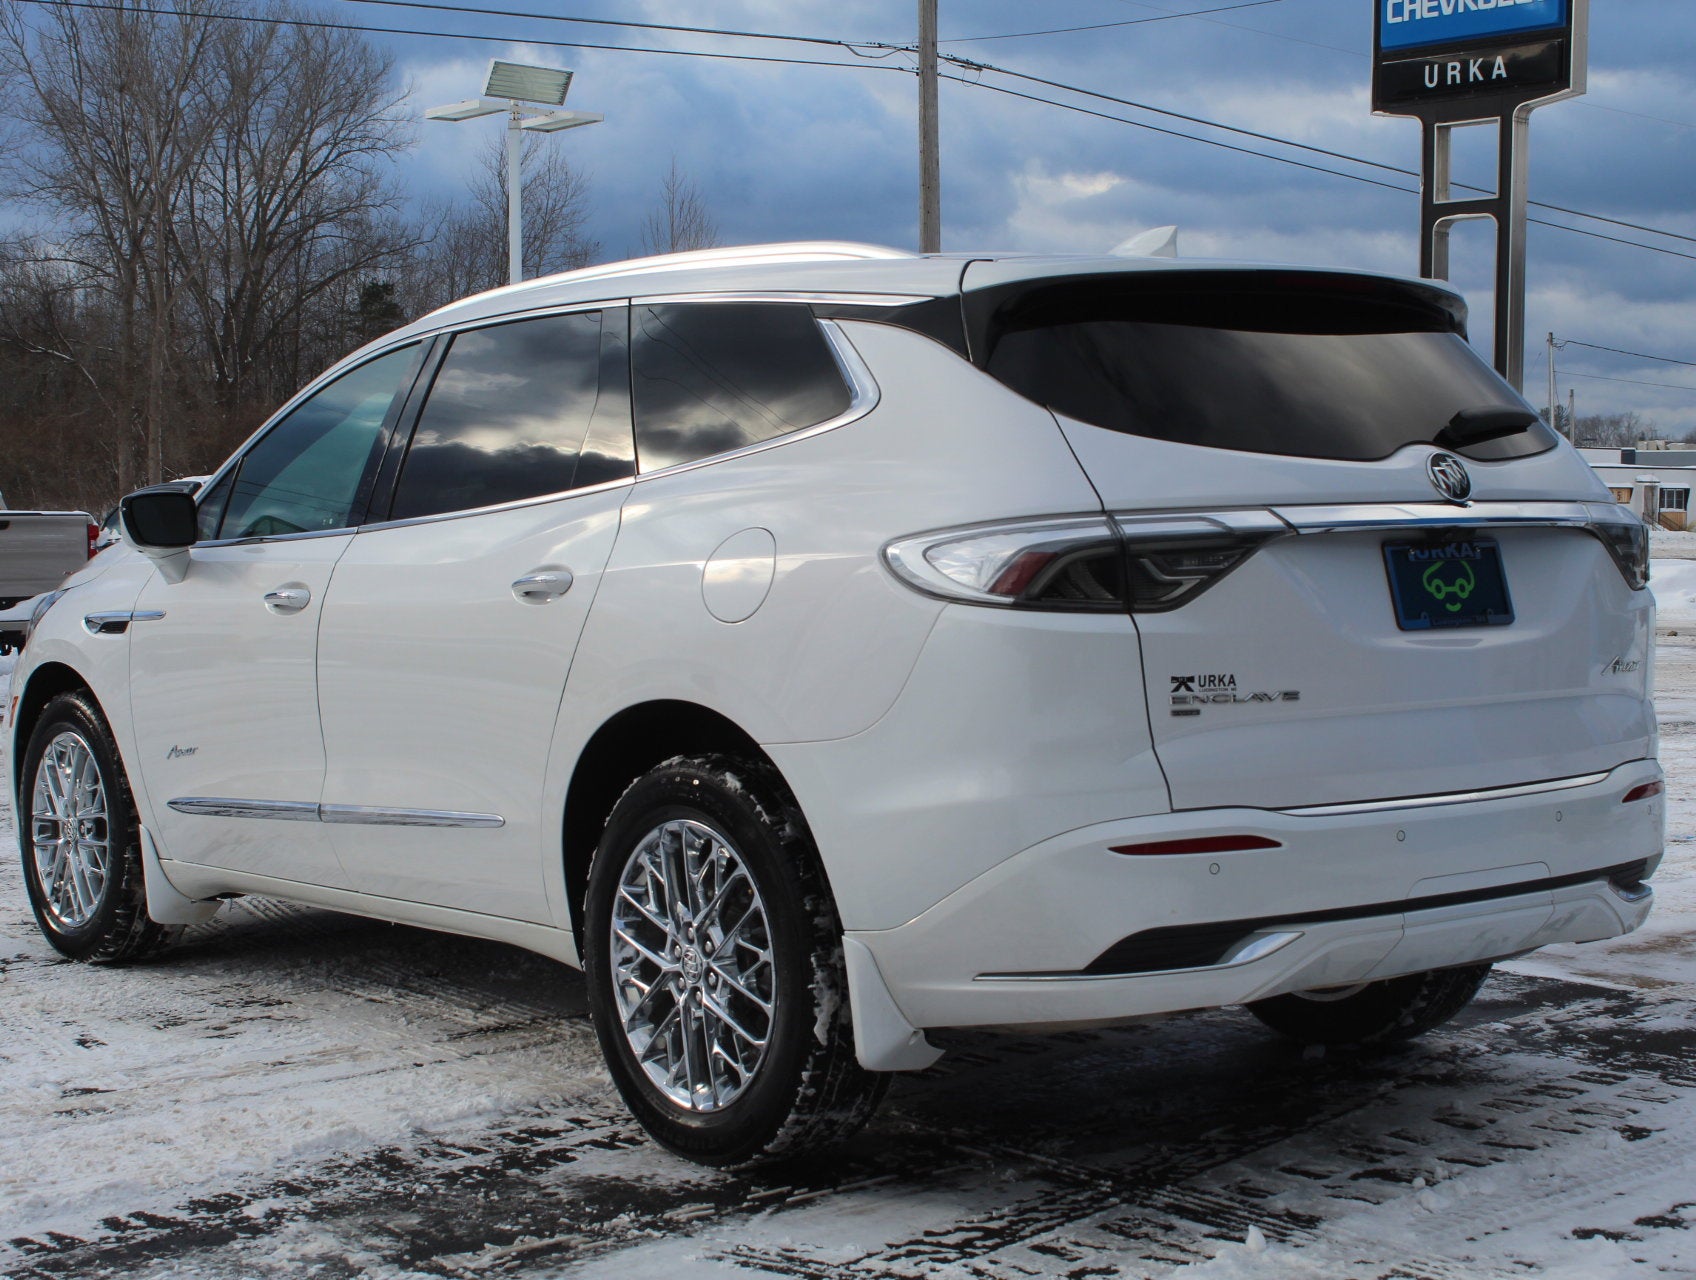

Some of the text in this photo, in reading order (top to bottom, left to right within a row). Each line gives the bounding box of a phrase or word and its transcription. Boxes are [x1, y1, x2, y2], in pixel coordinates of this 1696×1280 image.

[1387, 0, 1544, 23] CHEVR
[1424, 55, 1507, 88] URKA
[1198, 674, 1237, 687] URKA
[1169, 691, 1300, 705] ENCLAVE
